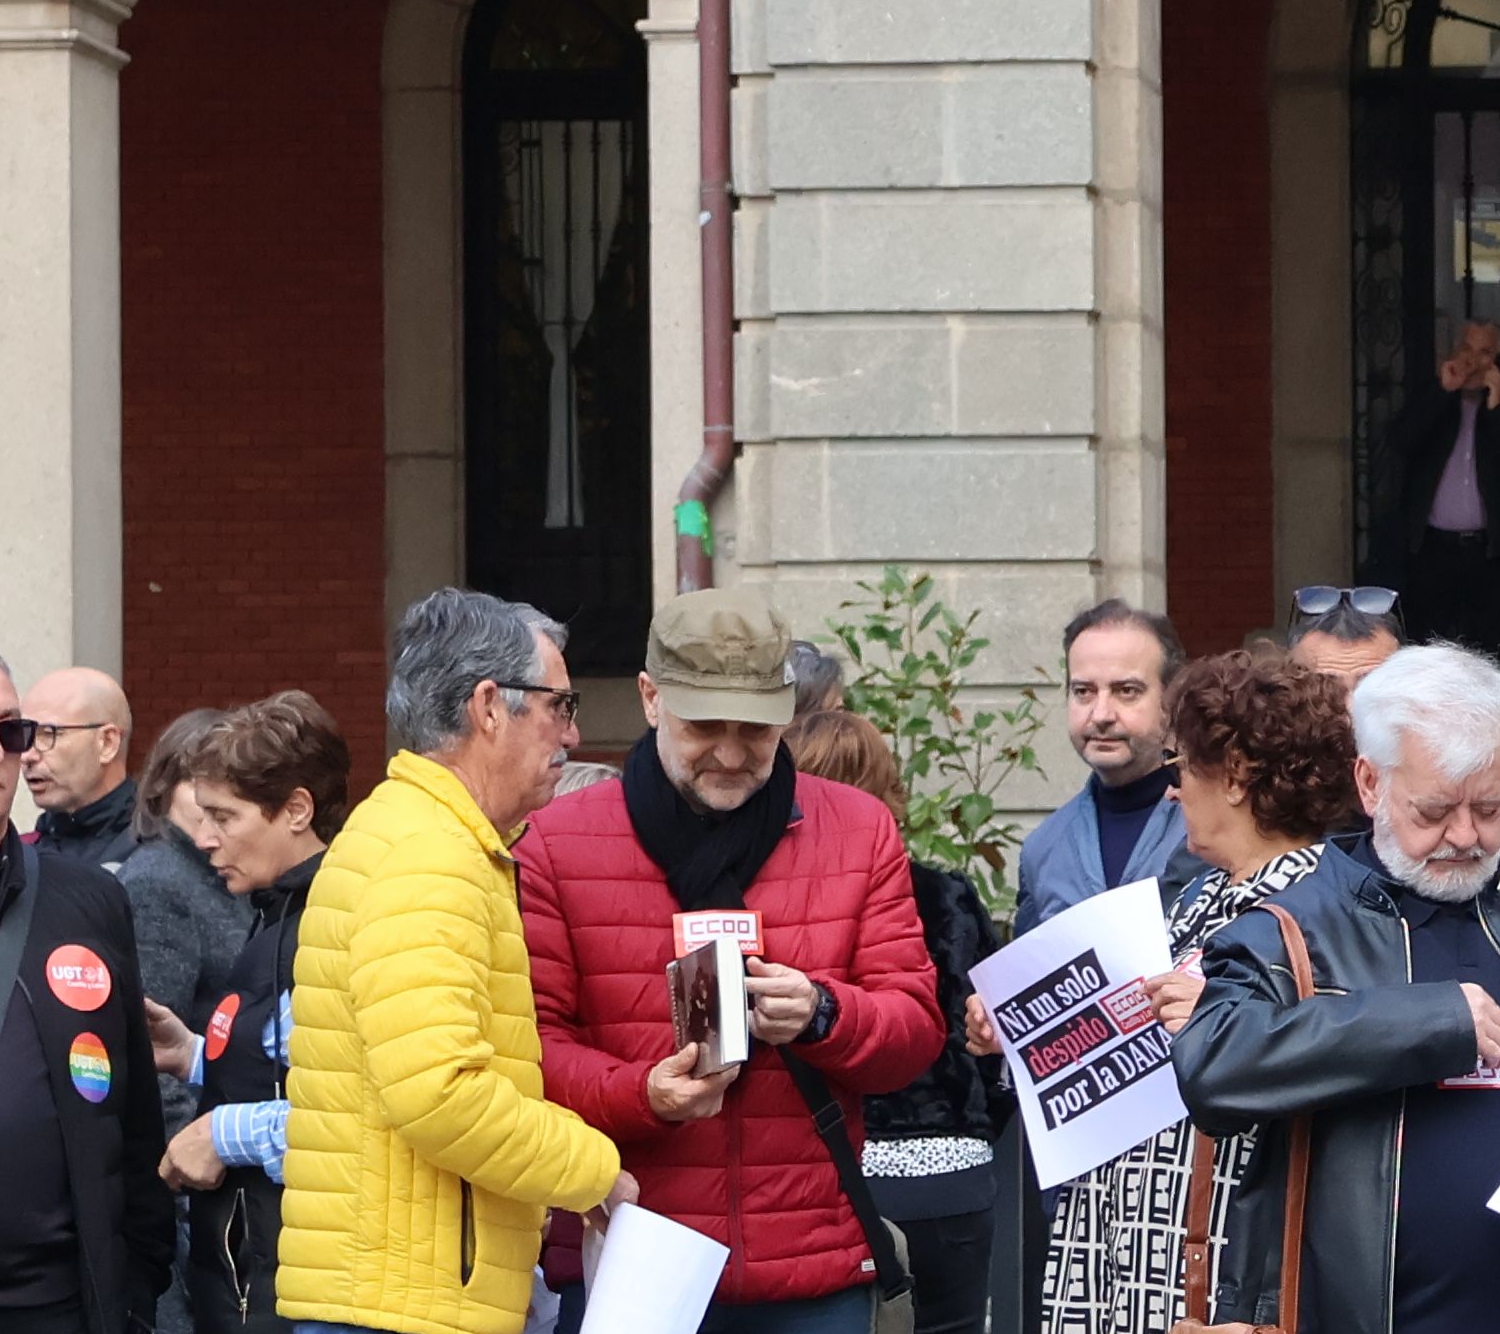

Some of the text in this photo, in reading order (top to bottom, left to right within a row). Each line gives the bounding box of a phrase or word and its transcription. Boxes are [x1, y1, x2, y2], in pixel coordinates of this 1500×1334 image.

[690, 920, 749, 934] CCOO
[741, 942, 758, 951] eón
[52, 966, 82, 980] UGT
[997, 964, 1101, 1041] Ni un solo
[1027, 1016, 1109, 1078] despido
[1046, 1025, 1174, 1126] por la DANA
